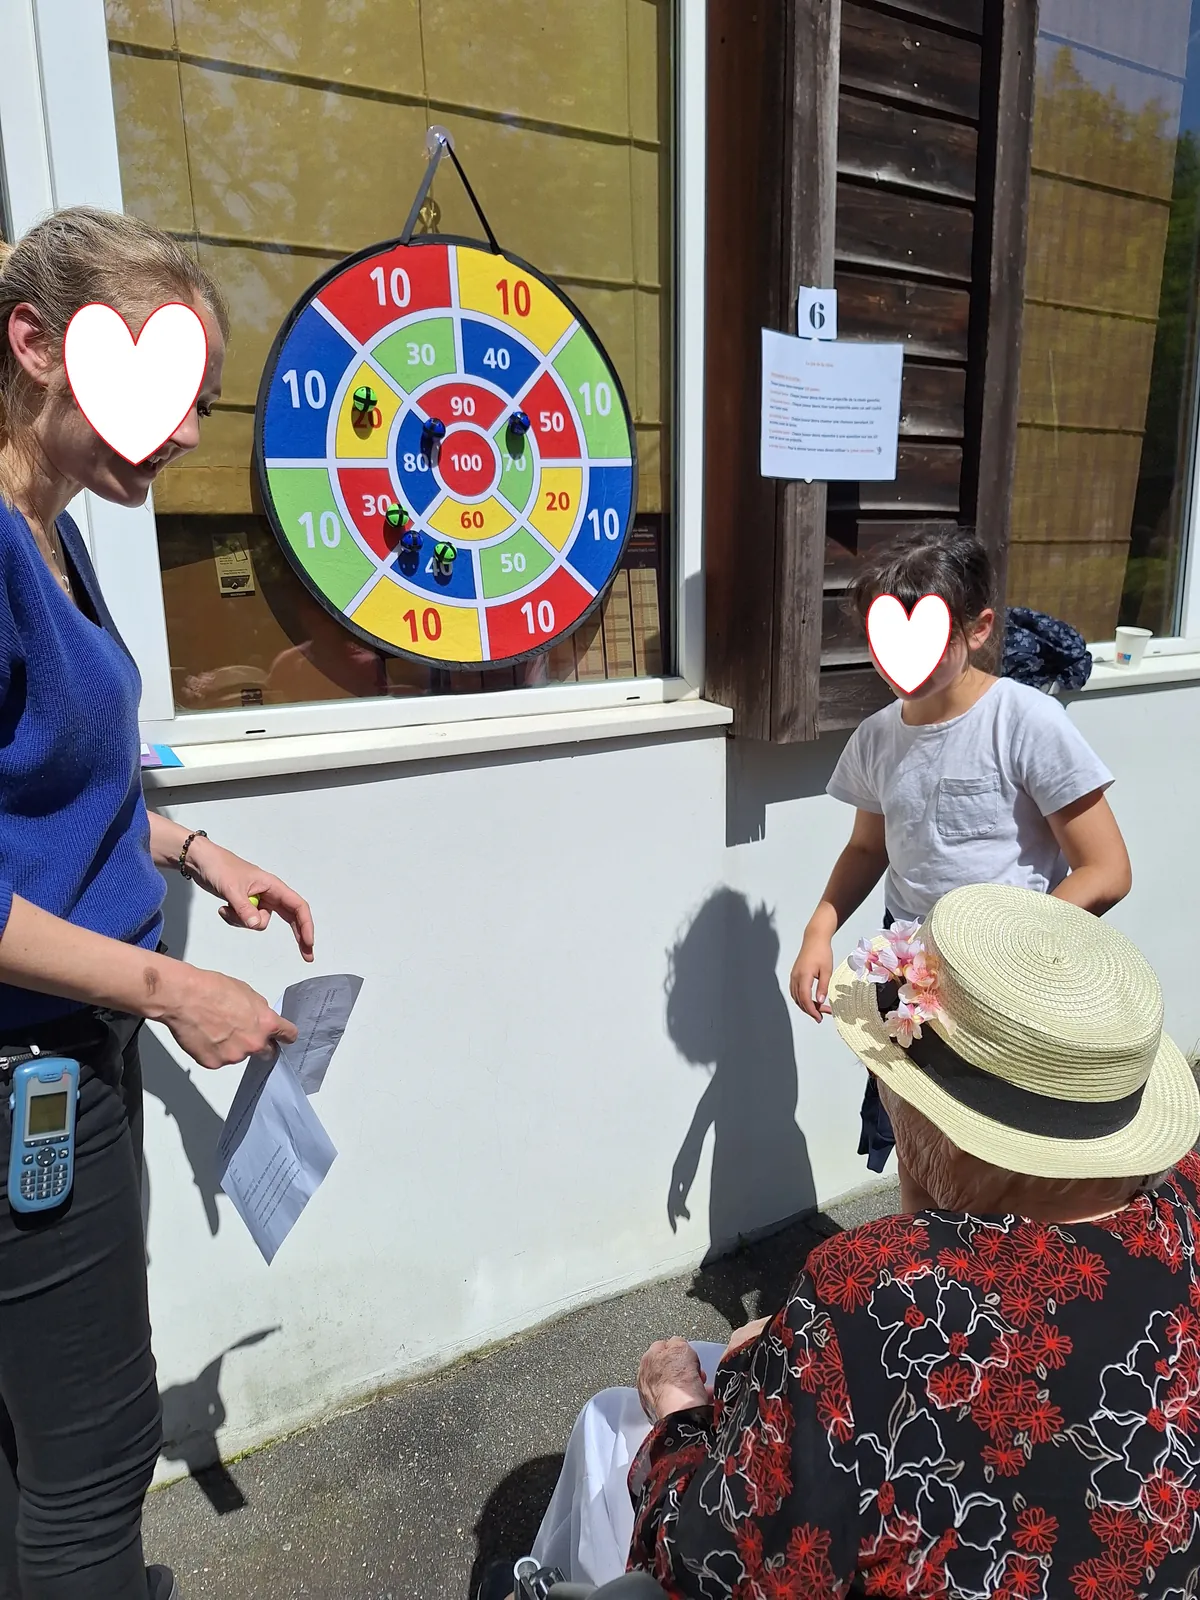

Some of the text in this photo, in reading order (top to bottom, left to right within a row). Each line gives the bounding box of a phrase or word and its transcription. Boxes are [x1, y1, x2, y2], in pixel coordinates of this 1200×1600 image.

[369, 266, 411, 308] 10
[495, 278, 531, 317] 10
[809, 301, 825, 329] 6
[406, 342, 436, 366] 30
[482, 347, 511, 370] 40
[281, 369, 327, 410] 10
[578, 382, 612, 417] 10
[353, 405, 383, 429] 20
[450, 396, 476, 417] 90
[539, 411, 565, 432] 50
[403, 452, 429, 473] 80
[450, 453, 483, 472] 100
[503, 453, 527, 472] 70
[361, 494, 393, 517] 30
[545, 491, 570, 511] 20
[297, 510, 341, 549] 10
[460, 510, 485, 529] 60
[587, 508, 620, 541] 10
[424, 556, 453, 577] 40
[500, 552, 527, 573] 50
[402, 607, 442, 643] 10
[520, 599, 555, 634] 10
